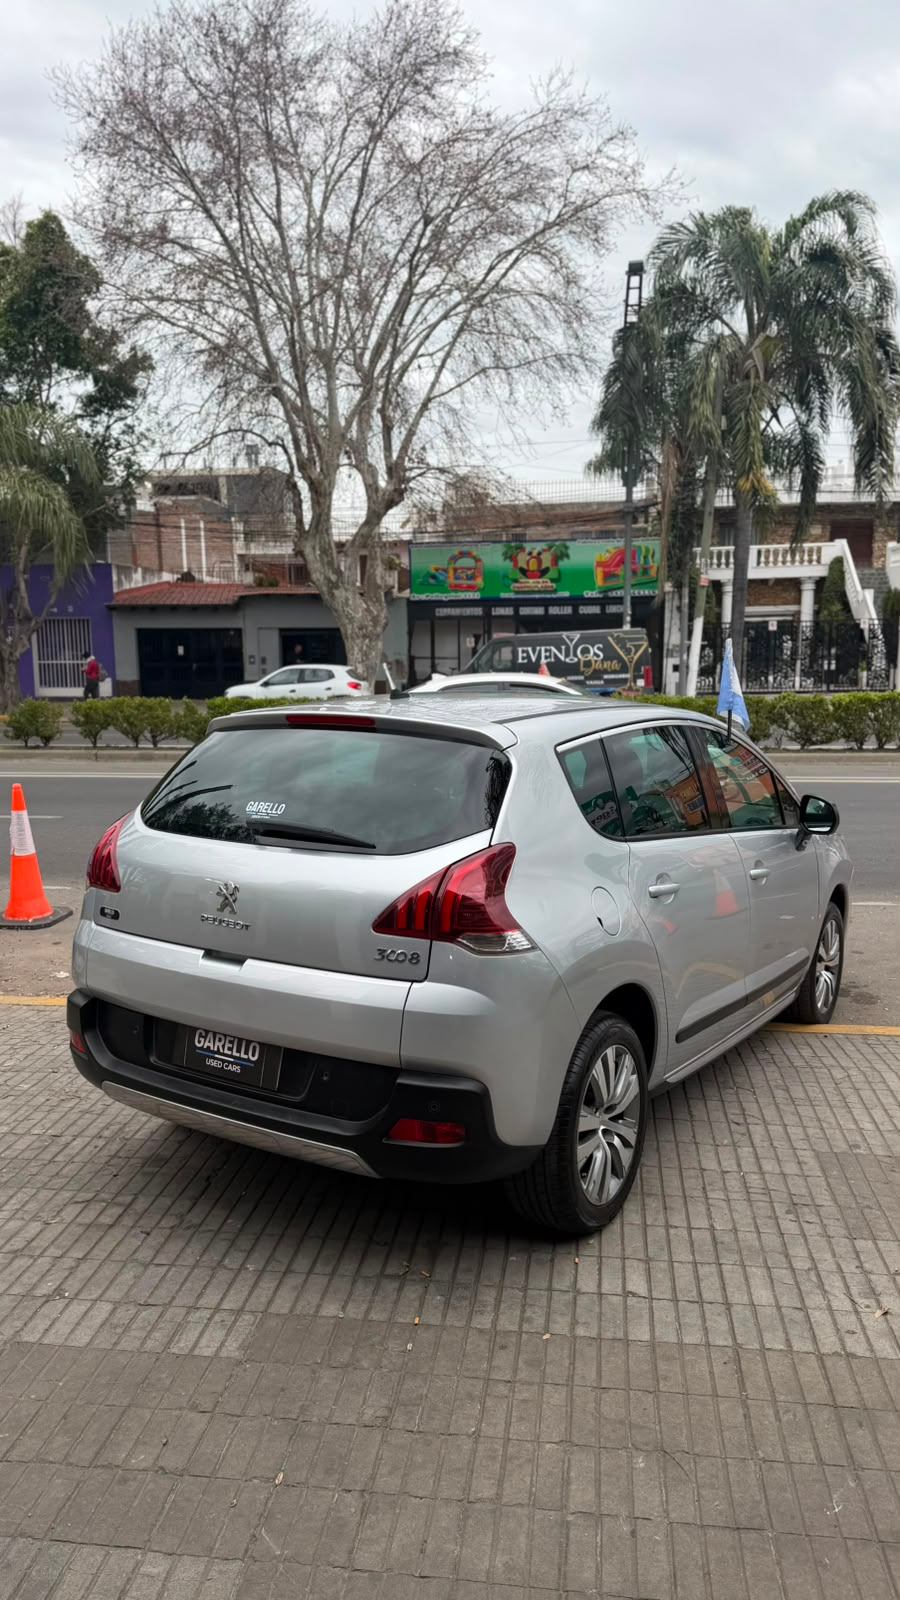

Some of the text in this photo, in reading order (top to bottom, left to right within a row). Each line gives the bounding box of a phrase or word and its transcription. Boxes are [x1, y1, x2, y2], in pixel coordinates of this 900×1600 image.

[548, 606, 573, 615] ROLLER
[580, 655, 622, 676] Dana
[245, 801, 286, 814] GARELLO
[200, 913, 251, 930] PEUGEOT
[194, 1029, 260, 1061] GARELLO
[205, 1057, 241, 1073] USED CARS
